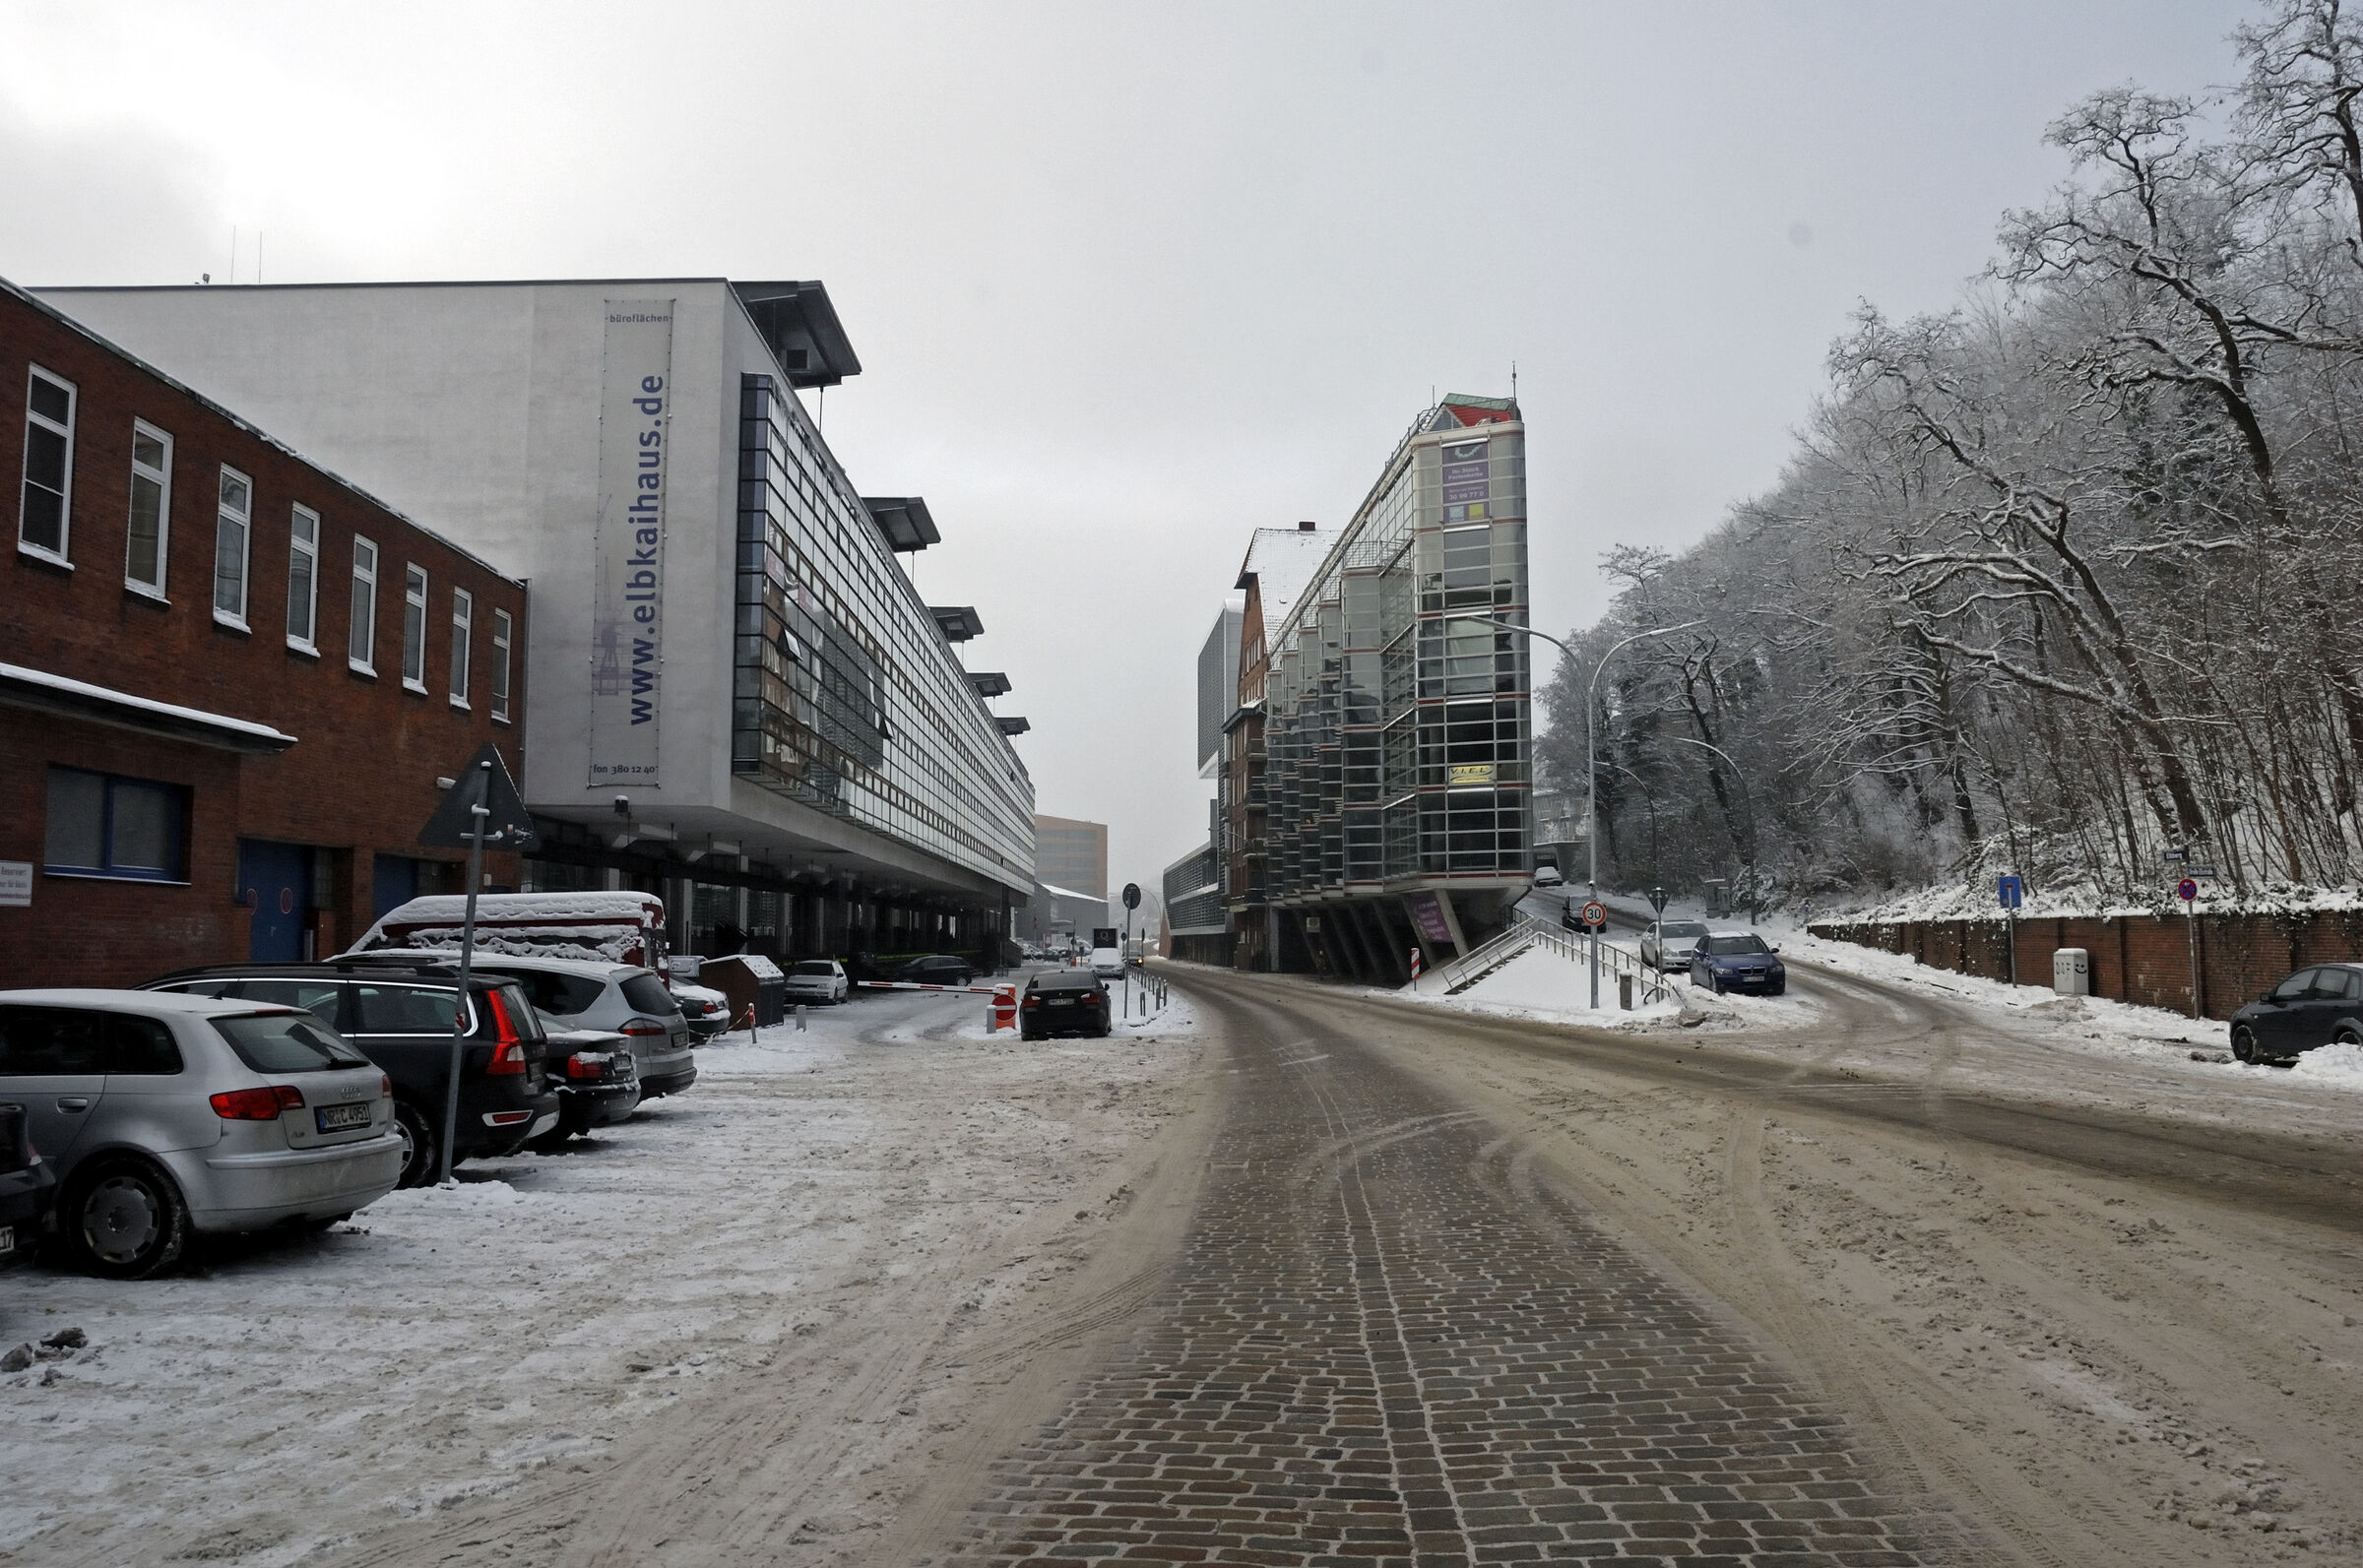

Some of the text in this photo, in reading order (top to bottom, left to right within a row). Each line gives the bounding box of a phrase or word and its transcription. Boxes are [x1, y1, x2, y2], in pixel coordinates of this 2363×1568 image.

[610, 314, 669, 323] büroflächen
[625, 375, 663, 725] www.elbkaihaus.de
[593, 764, 607, 773] fon
[611, 764, 629, 775] 380
[643, 766, 655, 775] 40
[1587, 909, 1601, 919] 30
[350, 1104, 369, 1121] 4951
